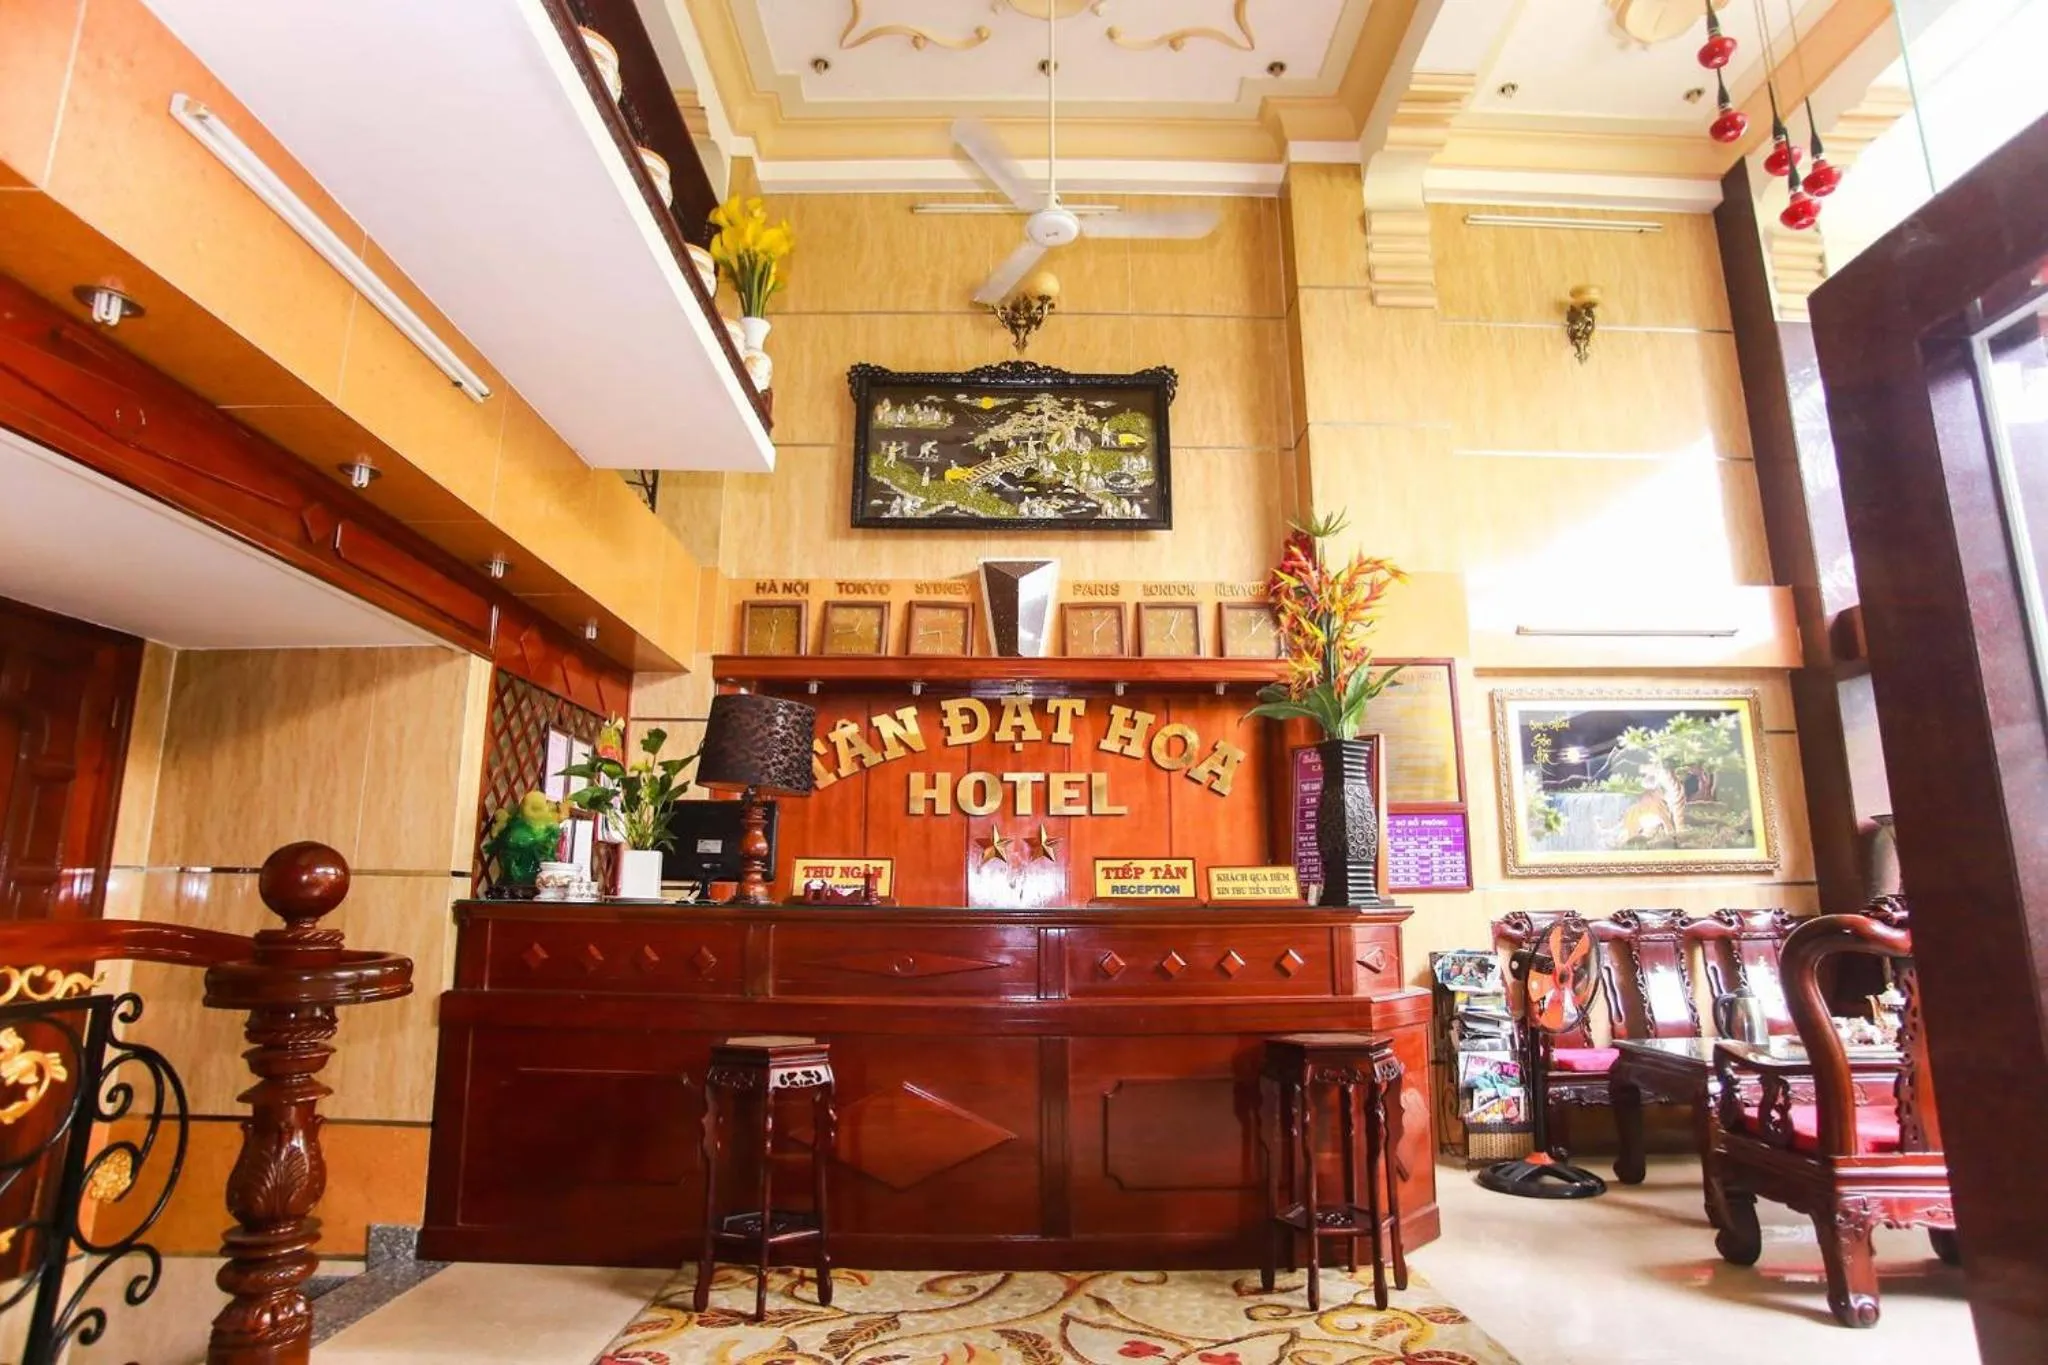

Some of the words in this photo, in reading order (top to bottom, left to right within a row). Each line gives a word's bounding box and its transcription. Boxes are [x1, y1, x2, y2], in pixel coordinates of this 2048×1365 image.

[755, 581, 778, 594] HÀ
[782, 582, 809, 595] NỘI
[835, 582, 891, 595] TOKYO
[914, 582, 972, 596] SYDNEY
[1072, 583, 1120, 597] PARIS
[1142, 583, 1197, 597] LONDON
[941, 697, 1086, 751] ĐẠT
[1099, 705, 1247, 796] HOA
[909, 772, 1128, 815] HOTEL
[803, 866, 835, 878] THU
[1102, 862, 1145, 880] TIẾP
[1150, 864, 1187, 880] TÂN
[1216, 872, 1248, 882] KHÁCH
[1250, 873, 1268, 883] QUA
[1111, 885, 1180, 895] RECEPTION
